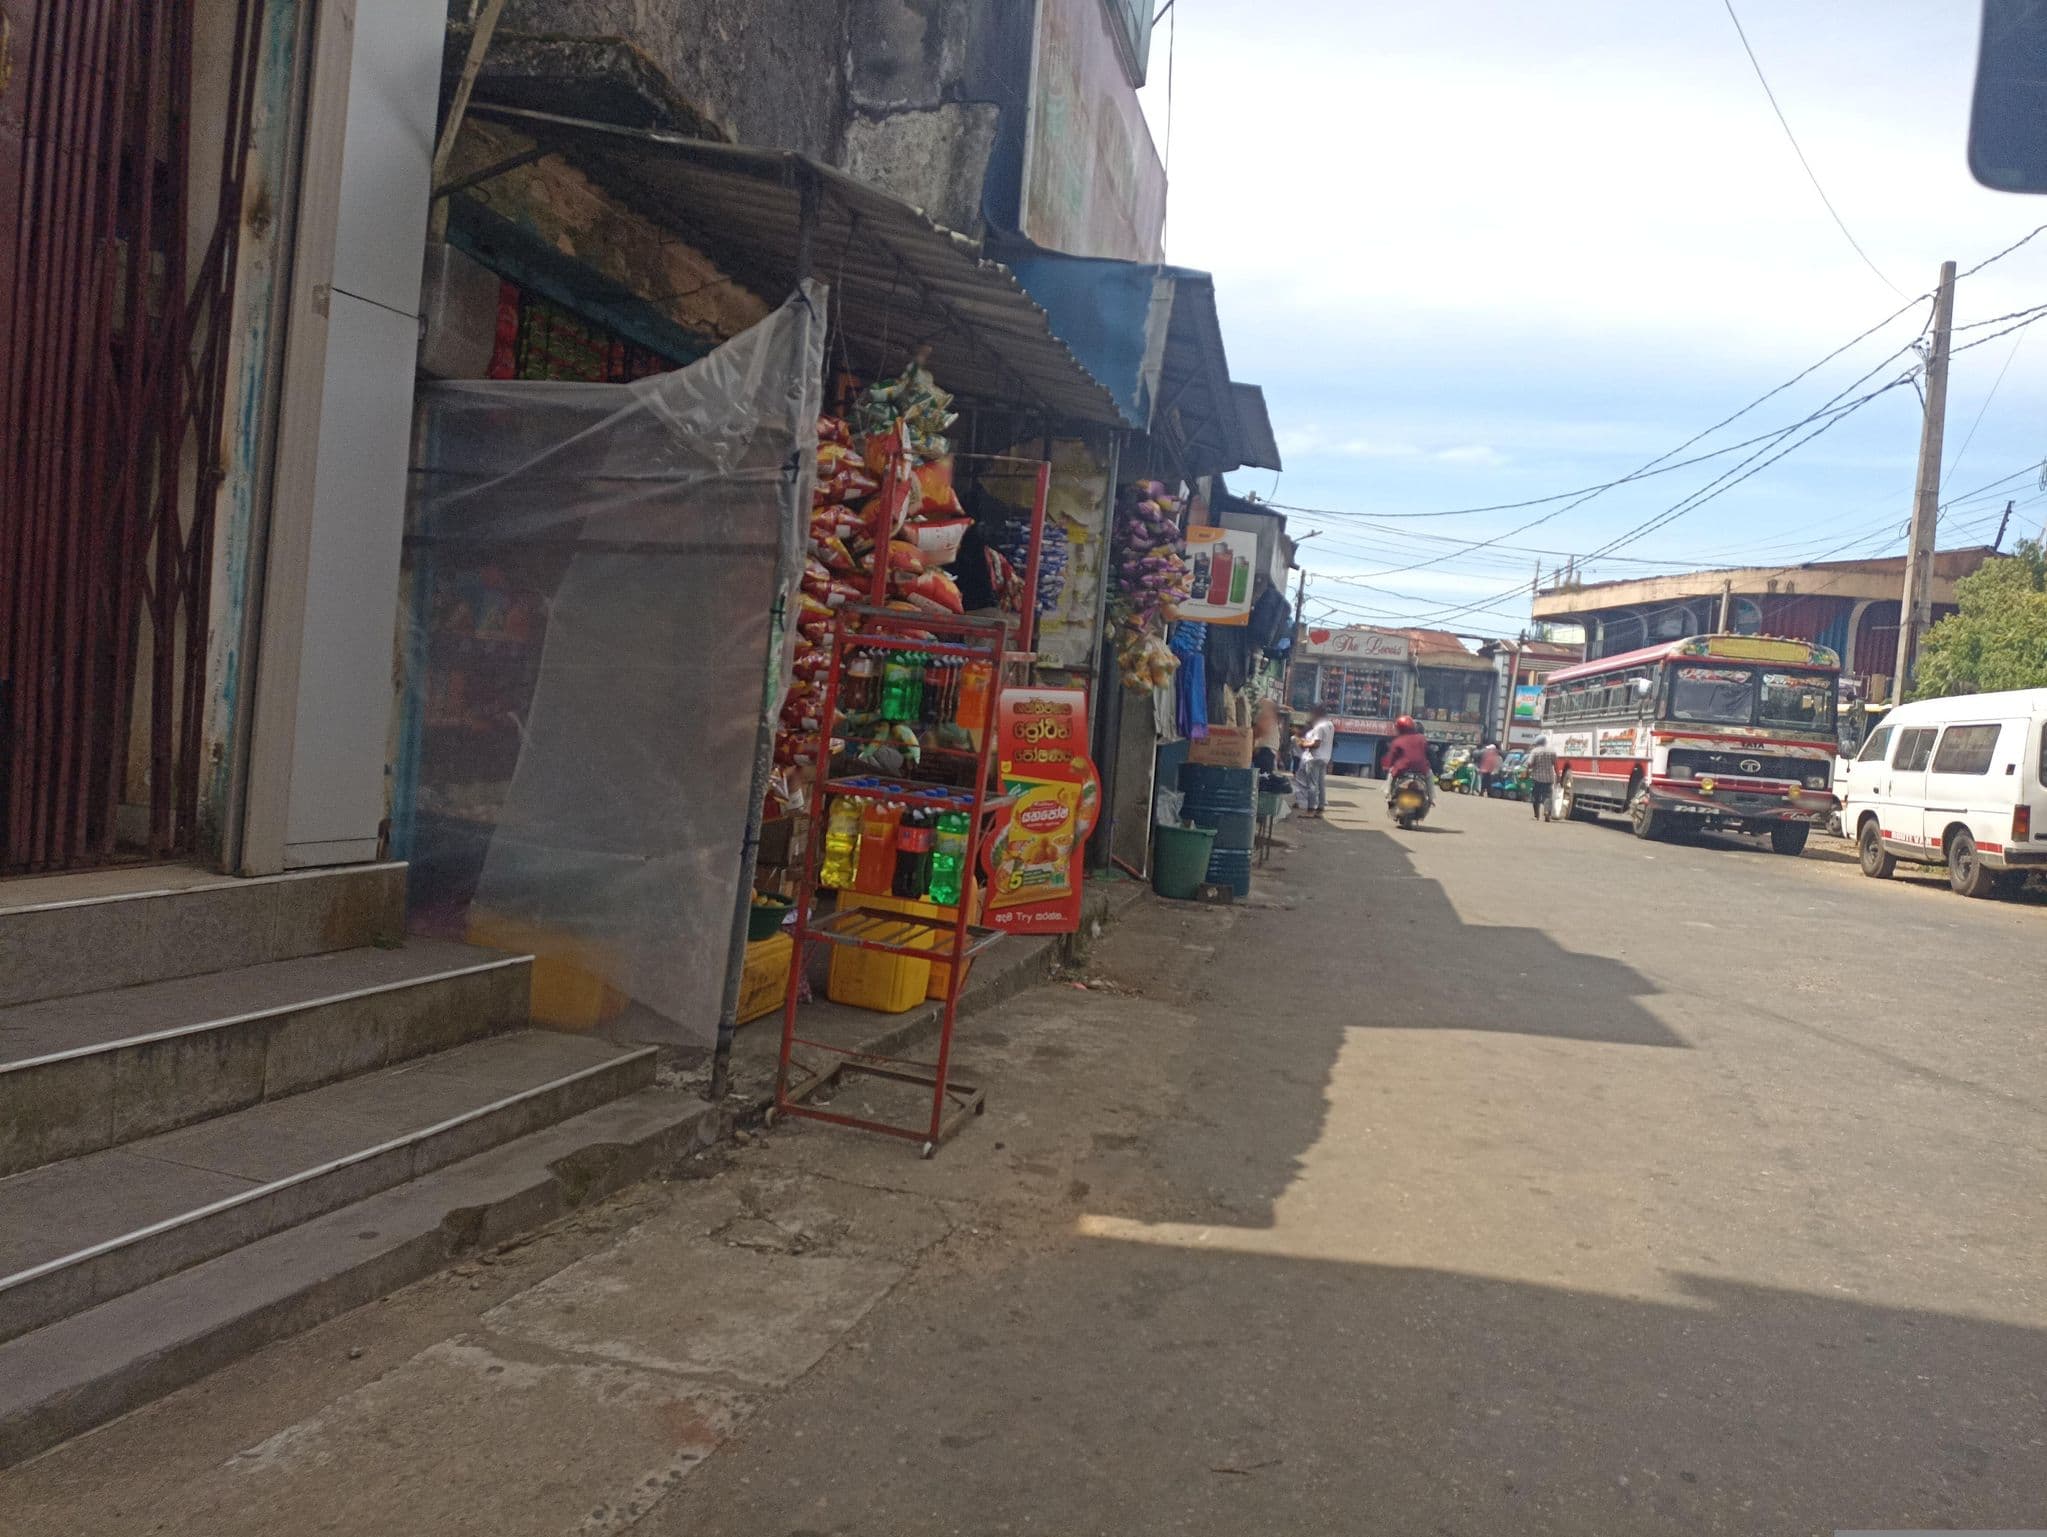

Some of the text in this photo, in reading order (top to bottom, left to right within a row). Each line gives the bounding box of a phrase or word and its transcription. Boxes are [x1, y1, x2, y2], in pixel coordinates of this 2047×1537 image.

[1332, 634, 1359, 653] The
[1009, 870, 1024, 889] 5
[1016, 911, 1033, 924] Try
